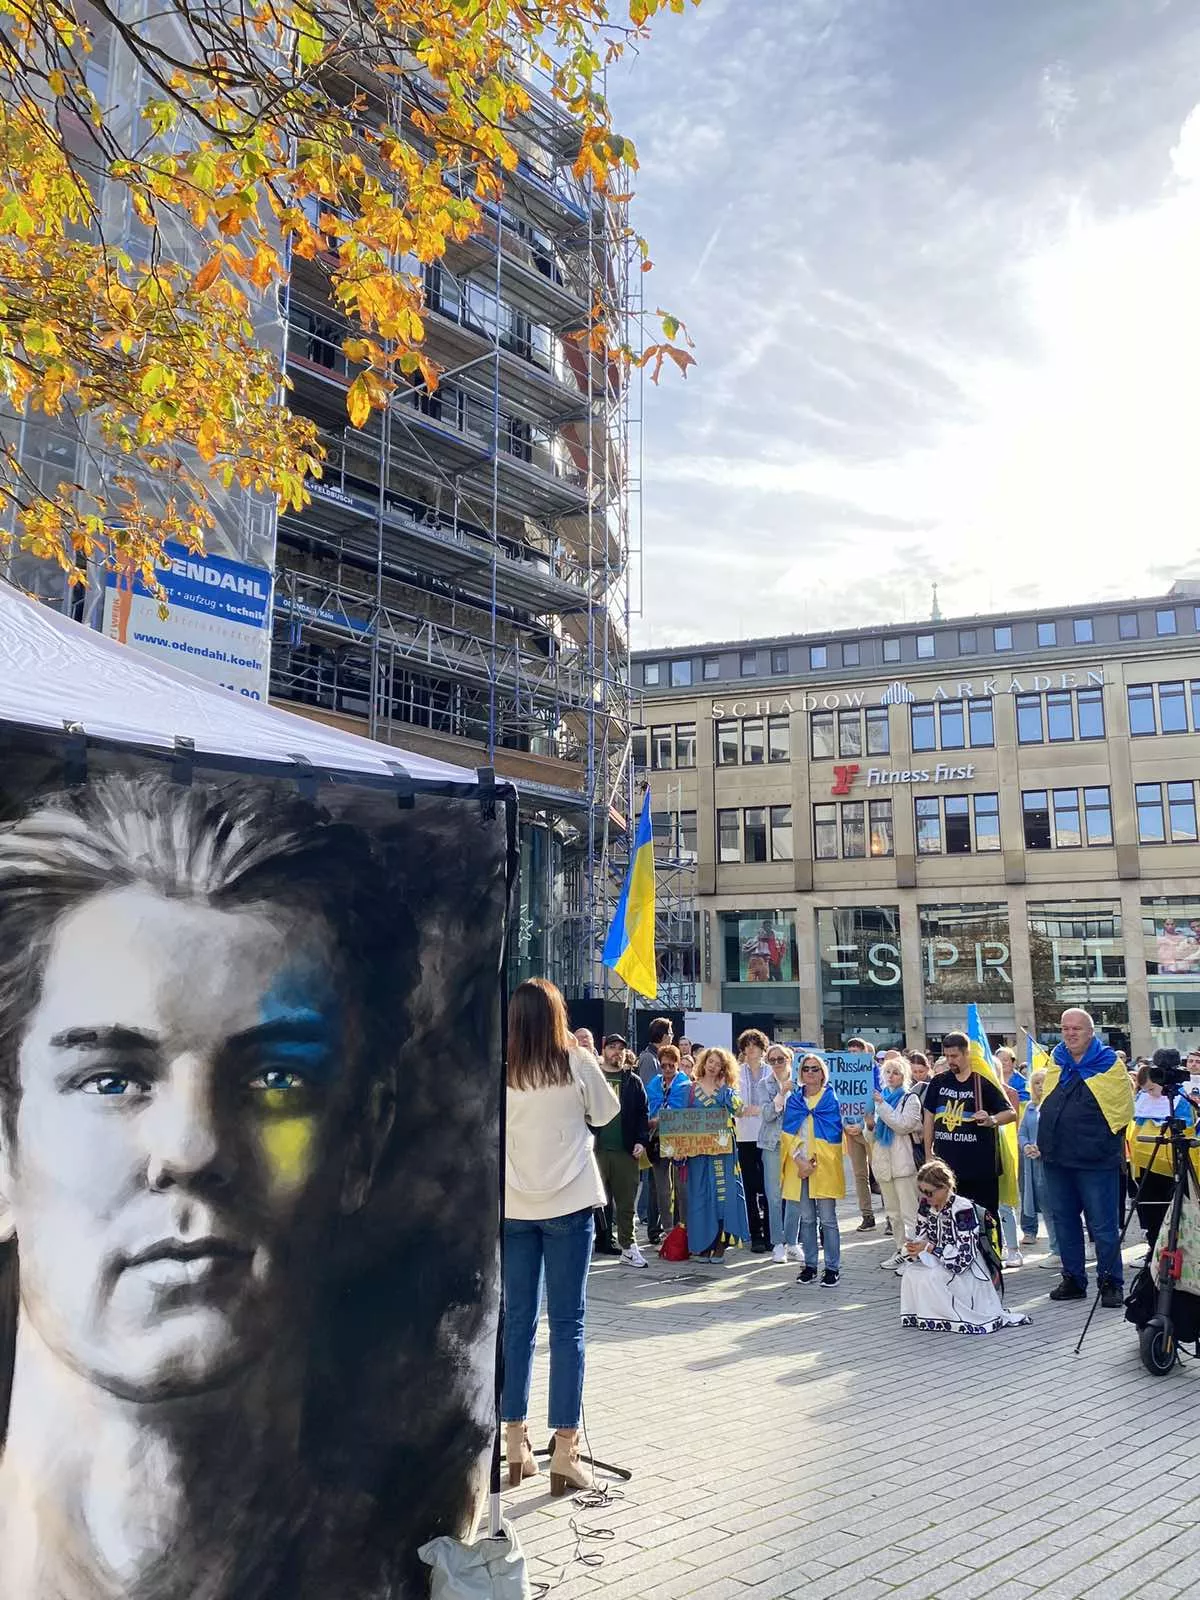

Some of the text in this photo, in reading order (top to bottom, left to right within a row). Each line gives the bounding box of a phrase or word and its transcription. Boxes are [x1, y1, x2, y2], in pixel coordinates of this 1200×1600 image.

[153, 556, 266, 600] DENDAHL
[184, 591, 217, 608] aufzug
[133, 631, 262, 671] www.odendahl.koeln
[711, 670, 1105, 719] SCHADOW ARKADEN
[867, 762, 976, 787] Fitness First
[827, 938, 1114, 986] ESPRIT
[834, 1079, 868, 1096] KRIEG
[954, 1133, 977, 1142] СЛАВА
